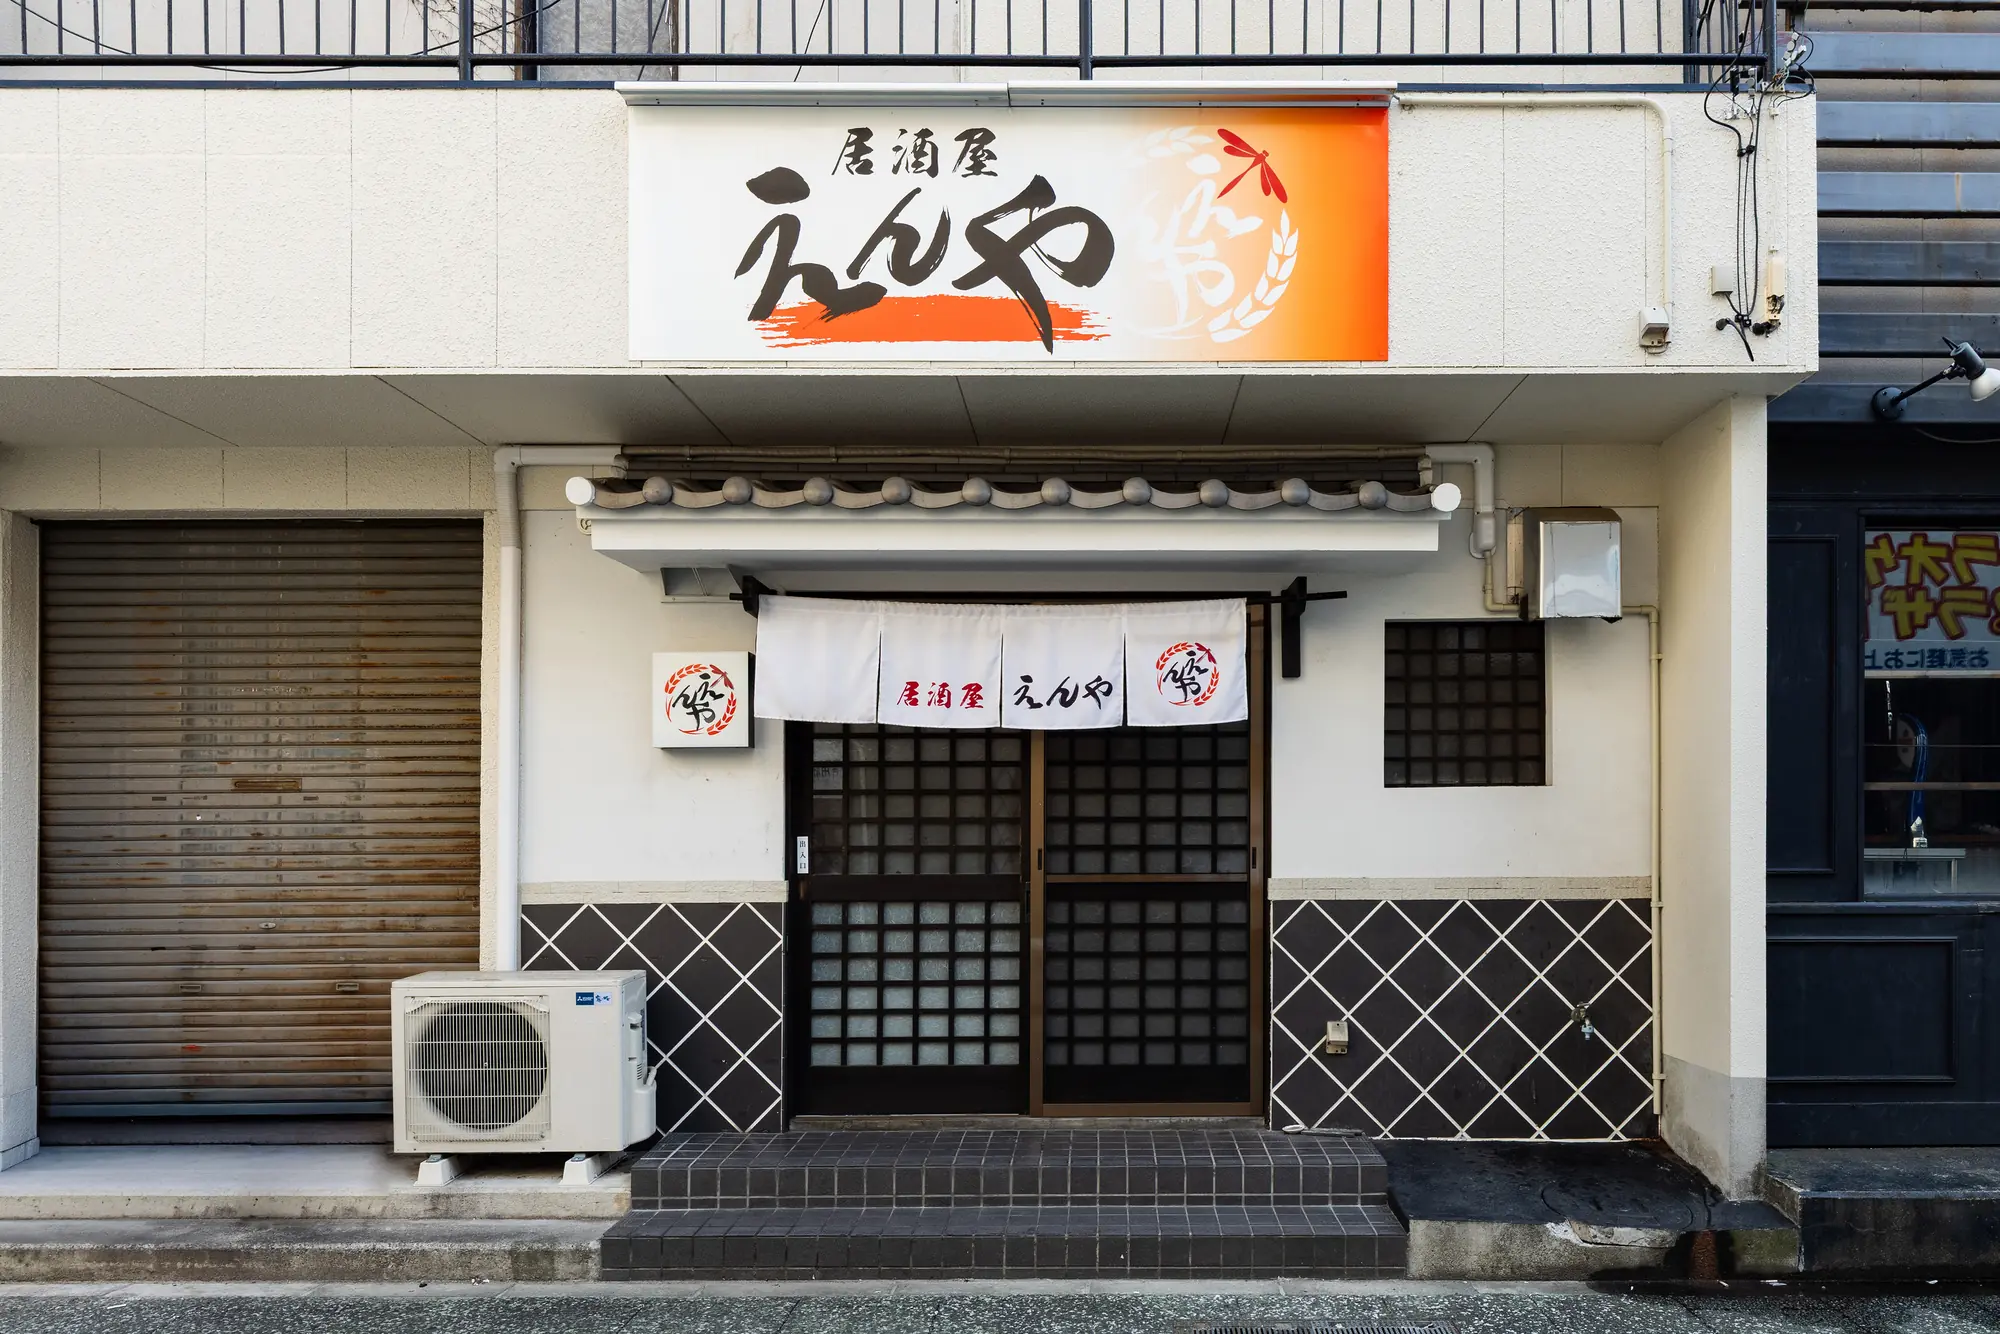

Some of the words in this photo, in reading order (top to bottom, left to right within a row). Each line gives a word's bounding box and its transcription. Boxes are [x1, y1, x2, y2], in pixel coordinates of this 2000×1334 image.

[830, 127, 999, 178] 居酒屋
[734, 166, 1115, 354] えんや
[896, 681, 984, 709] 居酒屋
[1013, 674, 1113, 710] えんや
[799, 840, 807, 869] 出入口
